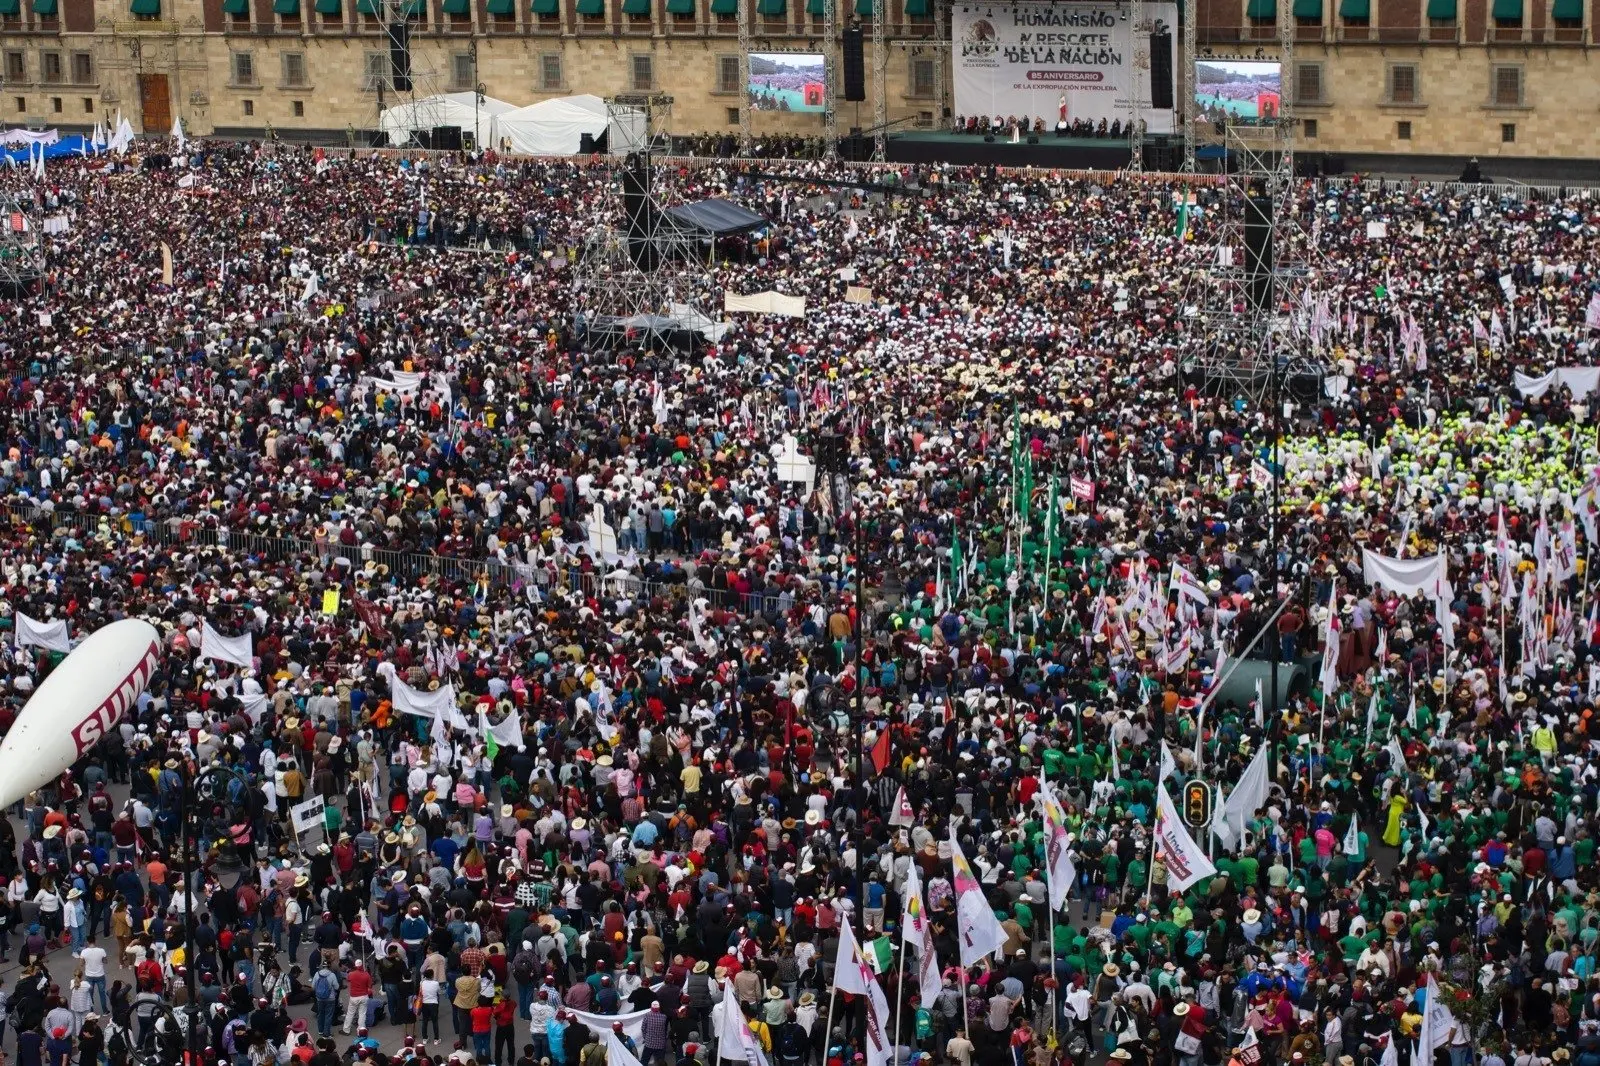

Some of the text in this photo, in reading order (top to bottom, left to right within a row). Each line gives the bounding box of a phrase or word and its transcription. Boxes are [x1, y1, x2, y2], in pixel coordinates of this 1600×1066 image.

[1014, 14, 1116, 28] HUMANISMO
[1036, 33, 1109, 46] RESCATE
[1008, 51, 1030, 64] DE
[1033, 51, 1056, 65] LA
[1043, 72, 1099, 81] ANIVERSARIO
[1032, 83, 1080, 91] EXPROPIACIÓN
